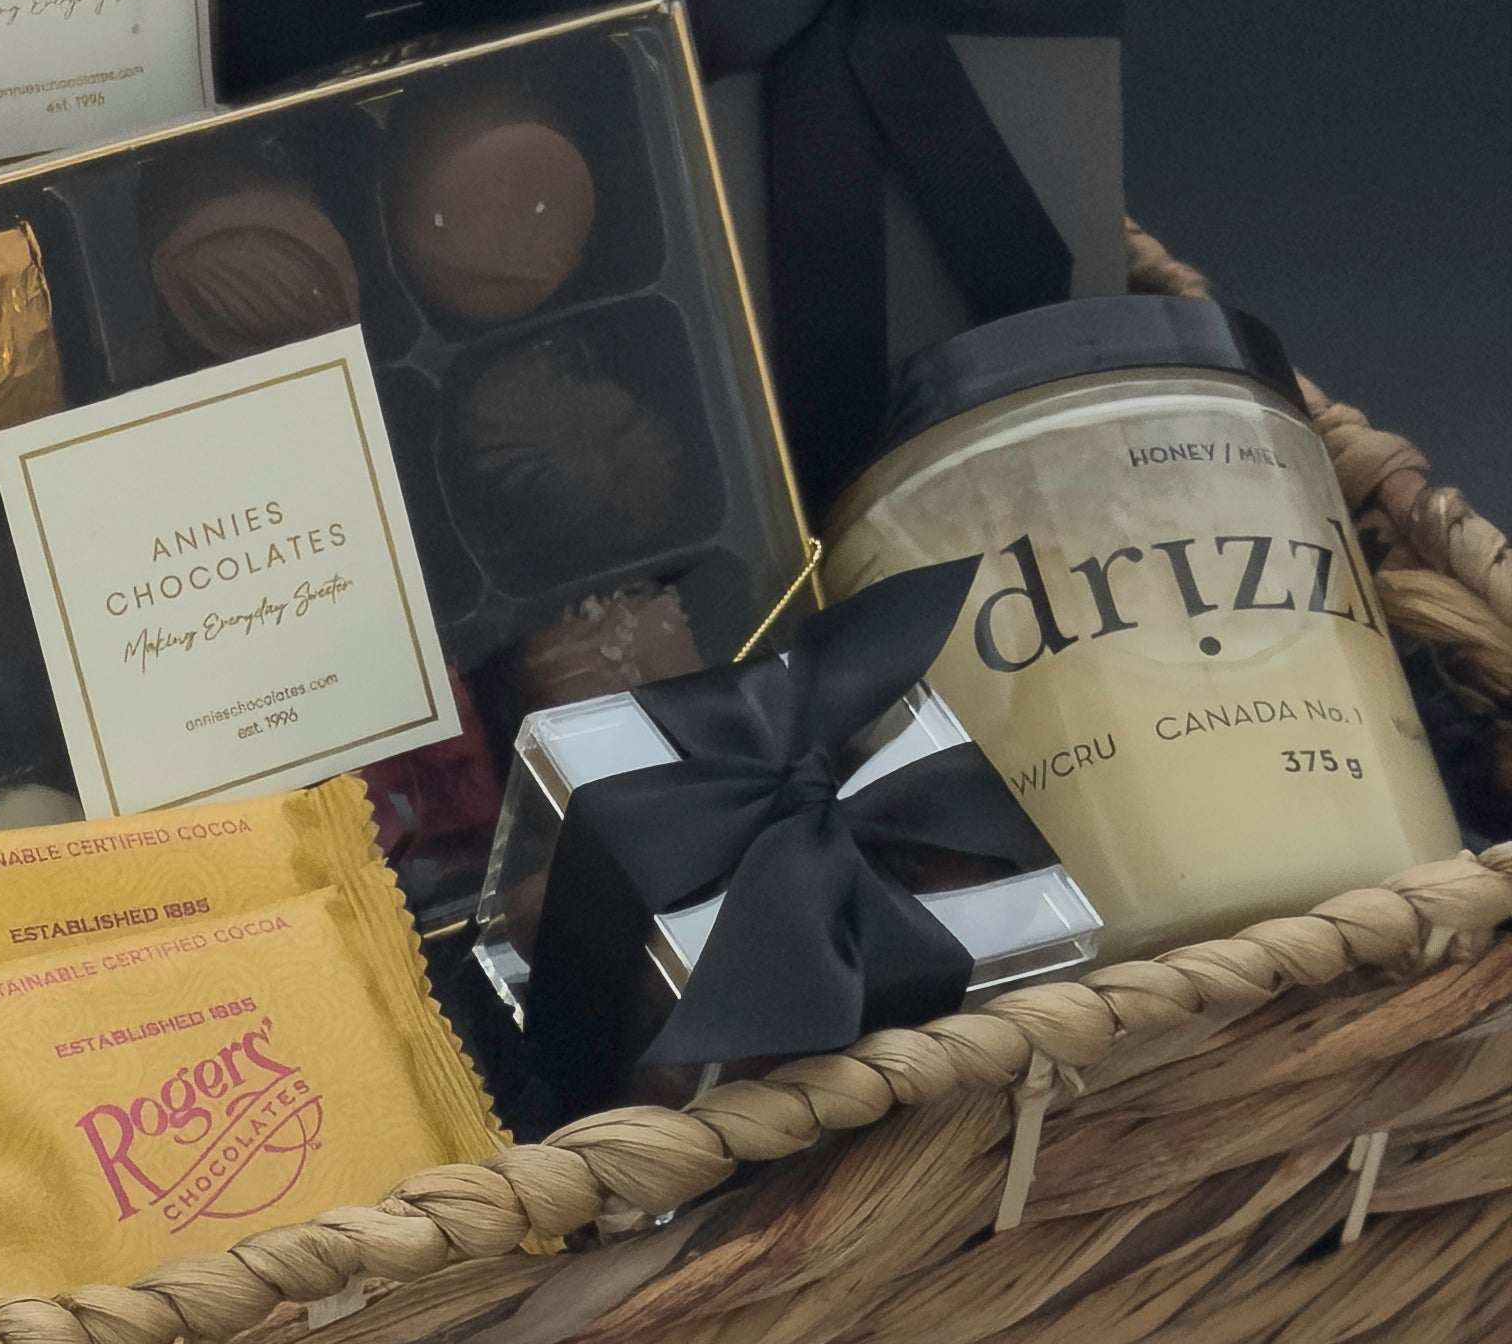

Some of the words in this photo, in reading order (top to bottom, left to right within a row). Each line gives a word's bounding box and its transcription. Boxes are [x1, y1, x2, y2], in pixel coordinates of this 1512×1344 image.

[1128, 443, 1215, 468] HONEY
[153, 501, 283, 562] ANNIES
[106, 523, 346, 616] CHOCOLATES
[124, 627, 197, 674] Making
[203, 596, 288, 641] Everyday
[186, 673, 338, 731] annieschocolates.com
[265, 708, 298, 729] 1996
[1156, 700, 1298, 741] CANADA
[1304, 699, 1349, 725] No.
[1280, 749, 1338, 773] 375
[1346, 757, 1363, 780] g
[66, 828, 170, 858] CERTIFIED
[177, 818, 252, 841] COCOA
[9, 905, 159, 944] ESTABLISHED
[163, 897, 211, 920] 1885
[102, 934, 208, 972] CERTIFIED
[213, 916, 291, 944] COCOA
[55, 1010, 205, 1059] ESTABLISHED
[209, 996, 257, 1020] 1885
[163, 1079, 310, 1221] CHOCOLATES
